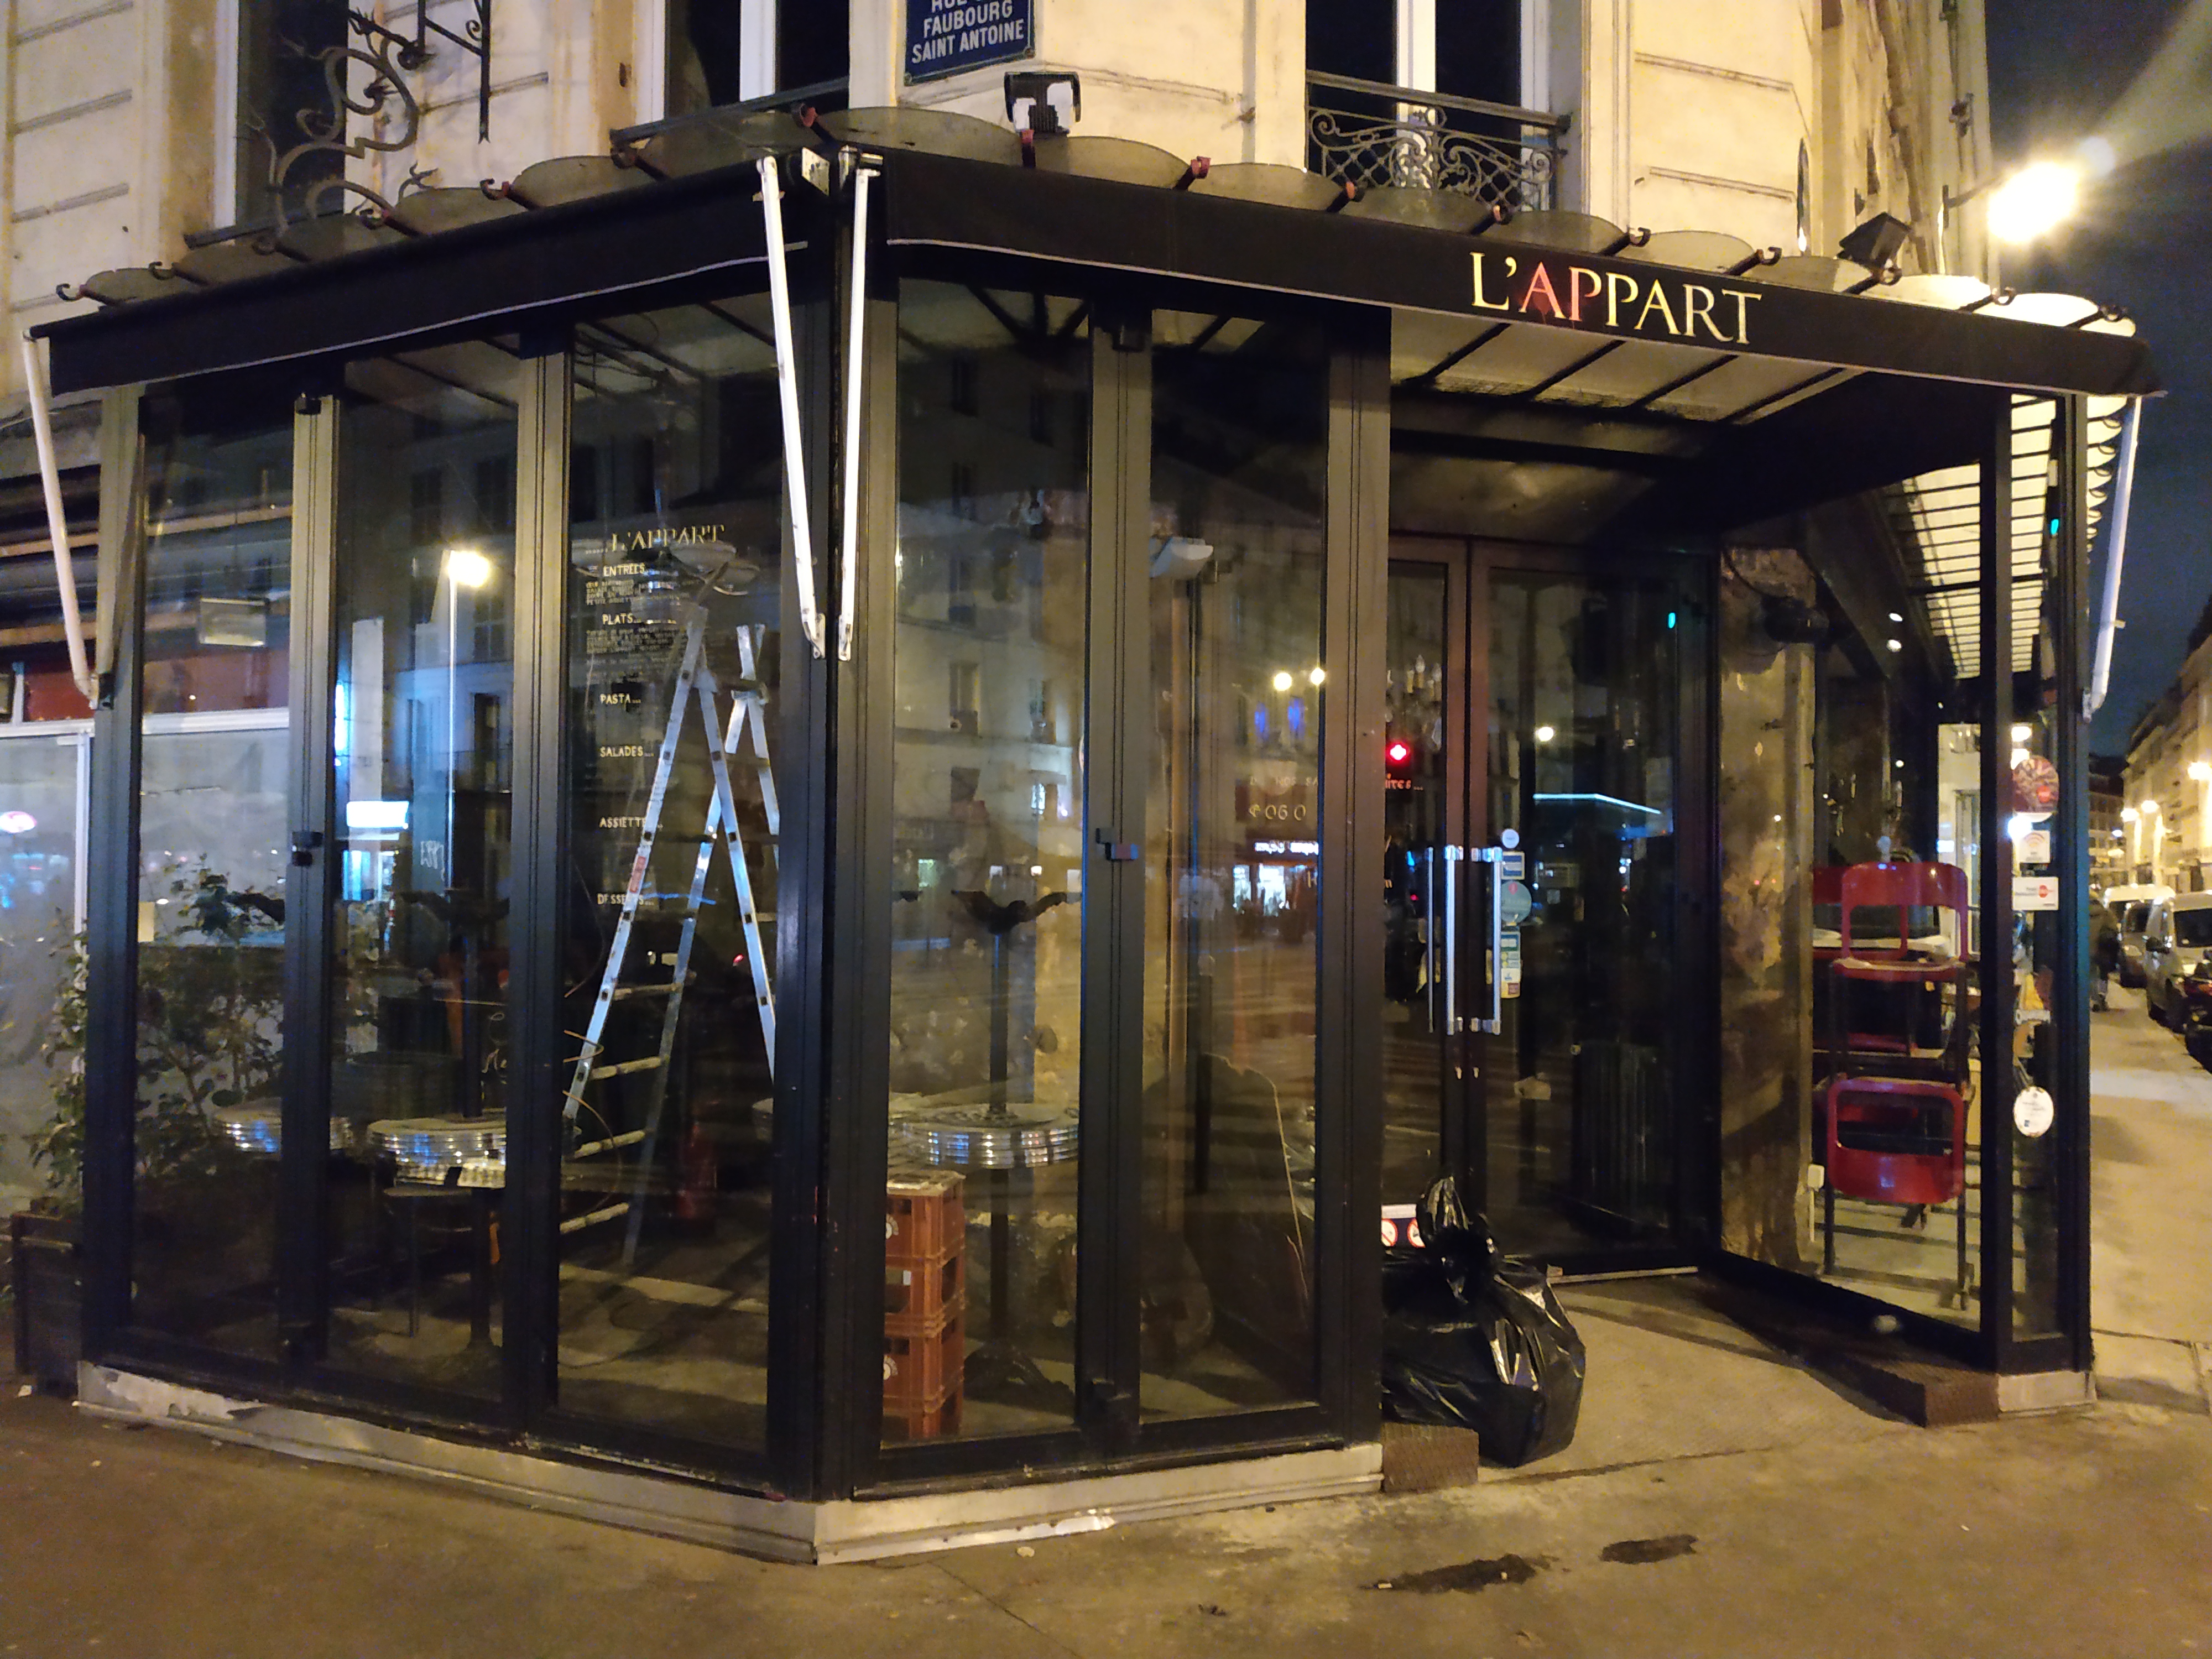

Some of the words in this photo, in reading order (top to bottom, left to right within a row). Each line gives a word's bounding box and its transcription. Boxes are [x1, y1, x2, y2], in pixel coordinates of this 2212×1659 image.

[924, 1, 1013, 38] FAUBOURG
[912, 35, 956, 64] SAINT
[959, 19, 1024, 52] ANTOINE
